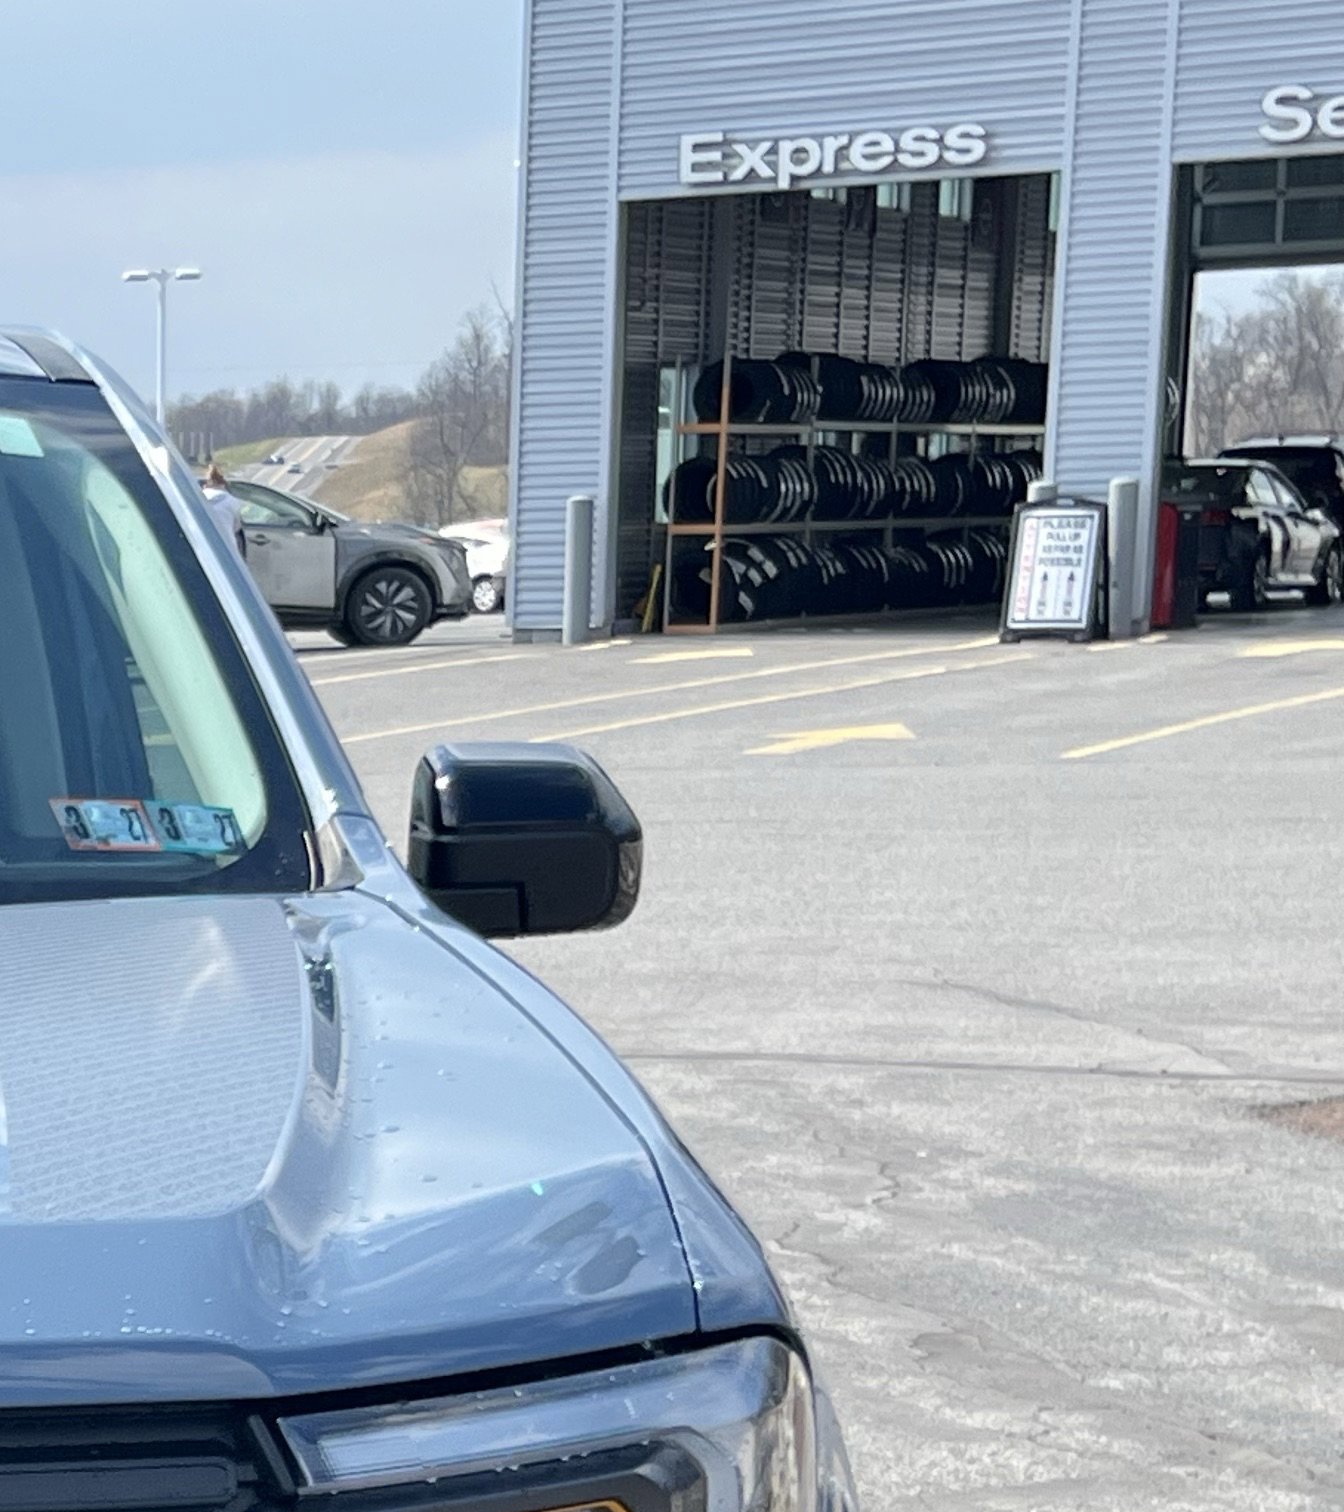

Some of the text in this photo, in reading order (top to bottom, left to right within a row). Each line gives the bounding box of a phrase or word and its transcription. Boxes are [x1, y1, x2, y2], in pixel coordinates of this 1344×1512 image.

[679, 123, 987, 189] Express
[64, 806, 149, 844] 3 27
[158, 807, 239, 847] 3 27
